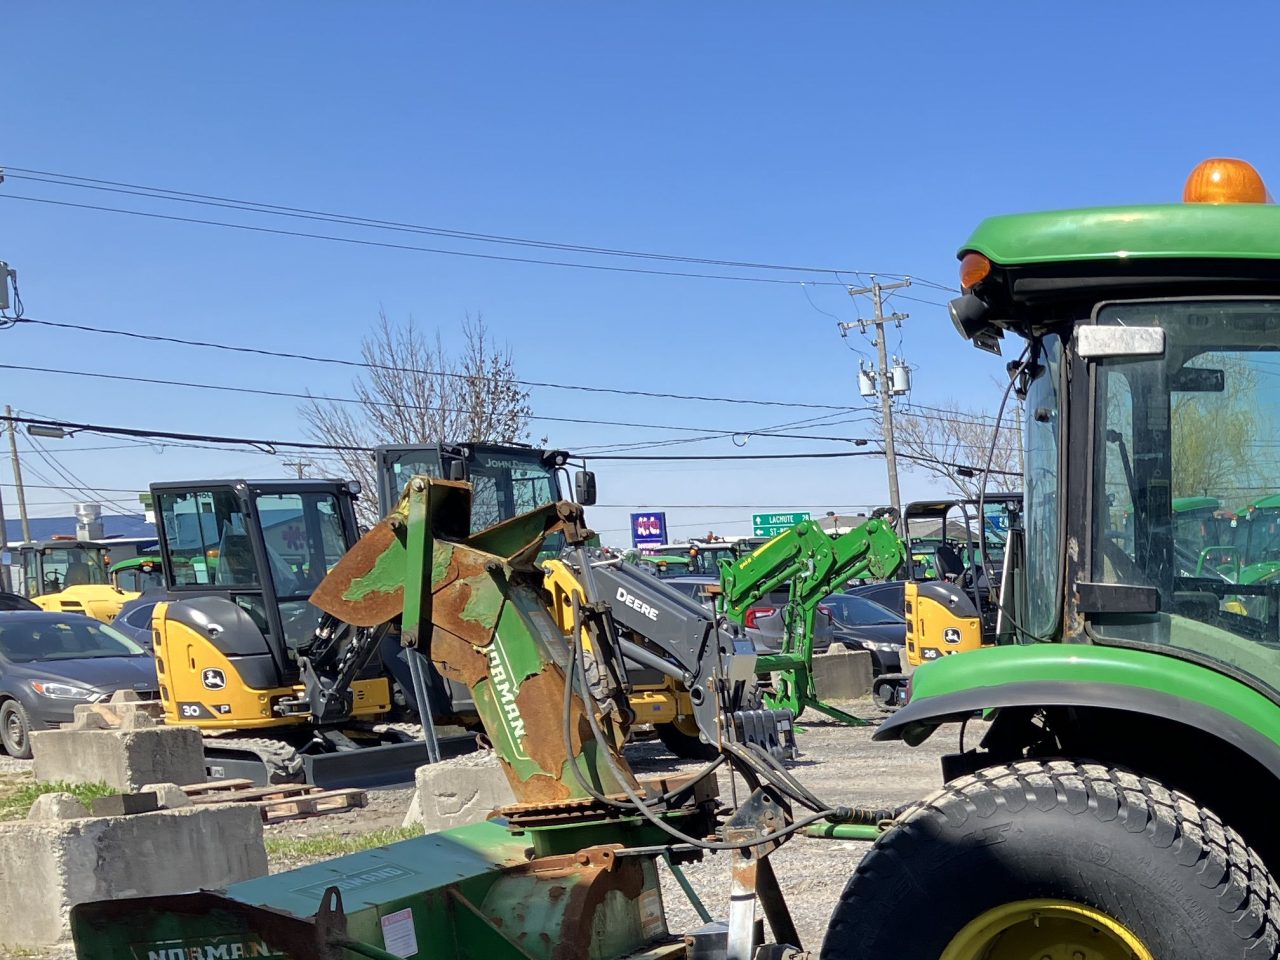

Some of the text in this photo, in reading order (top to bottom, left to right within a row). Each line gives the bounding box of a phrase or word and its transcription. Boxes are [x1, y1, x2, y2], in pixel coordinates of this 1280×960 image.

[769, 515, 794, 524] LACHUTE
[616, 587, 658, 621] DEERE
[924, 650, 936, 658] 26
[486, 643, 528, 753] ORMAN
[182, 705, 230, 716] 30 P
